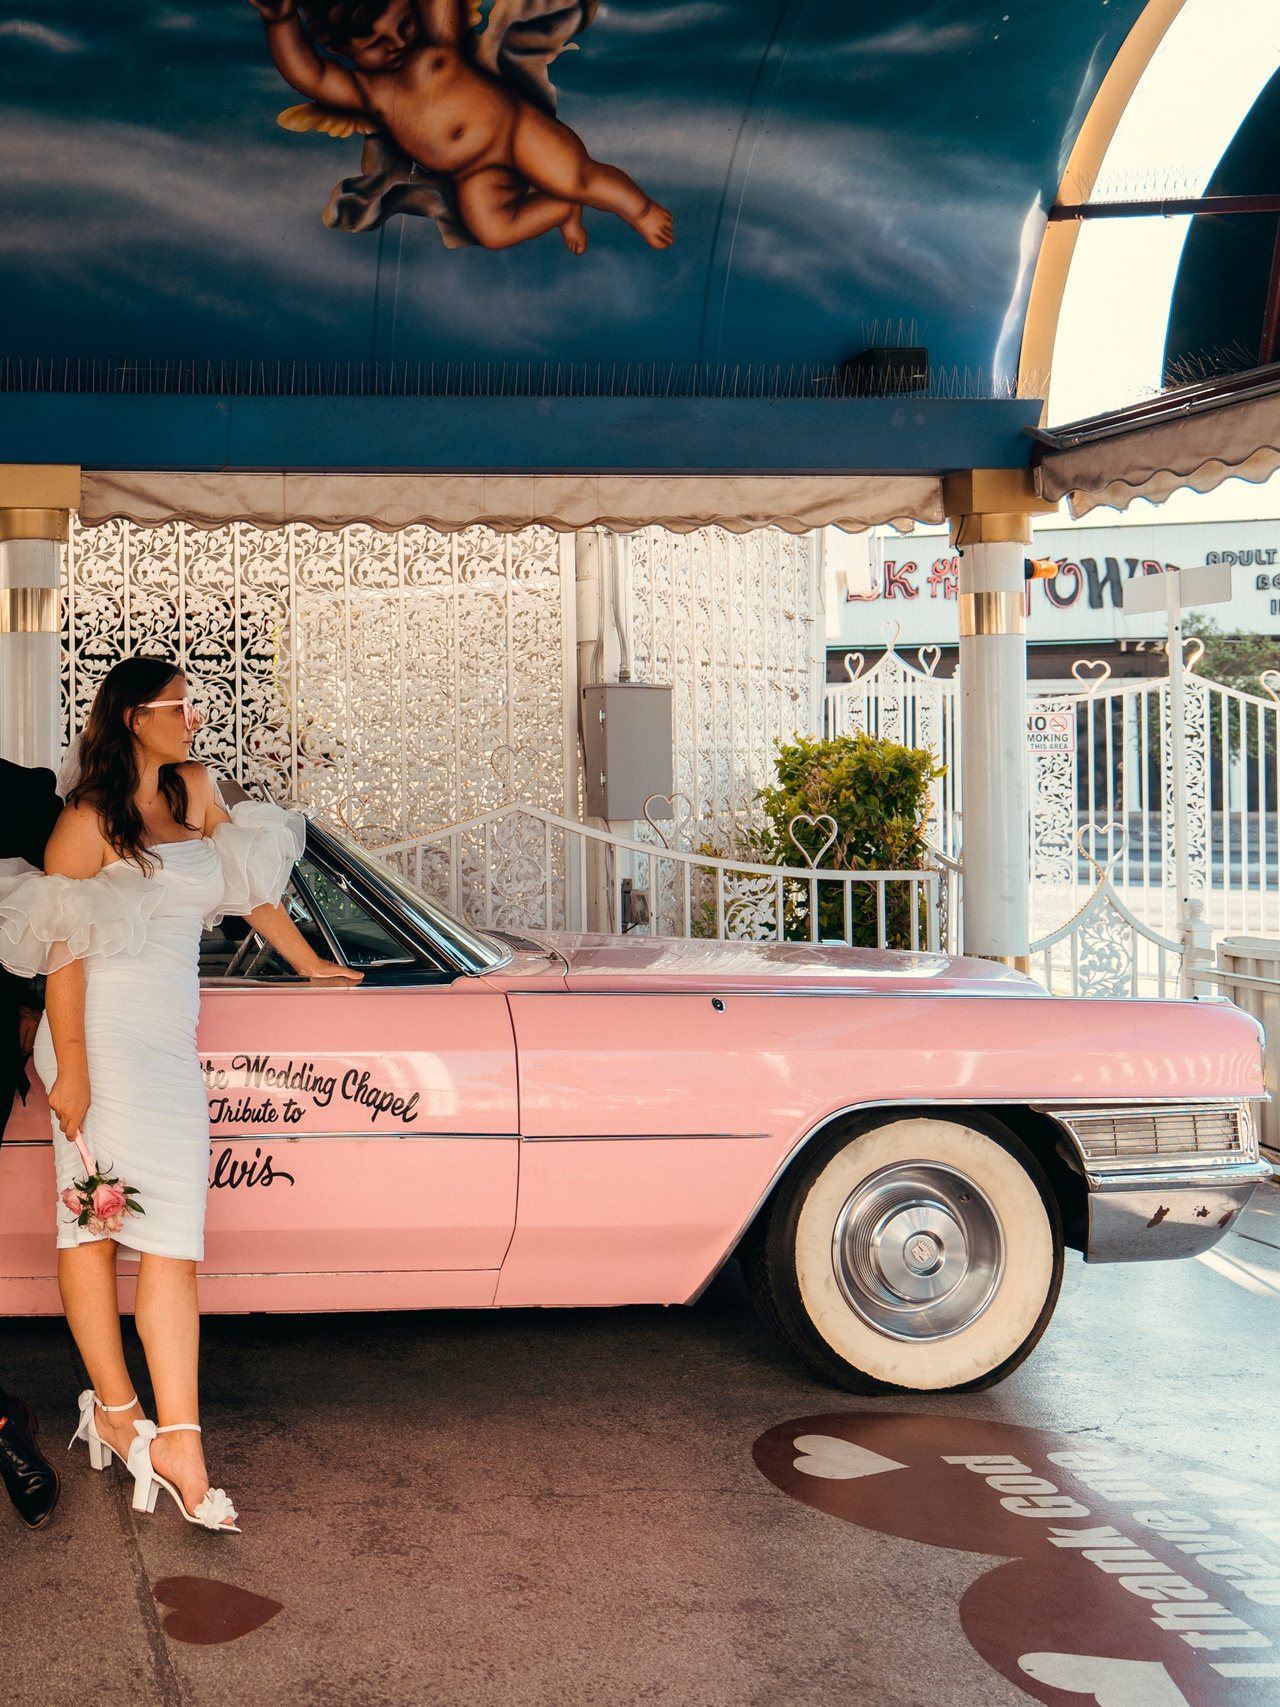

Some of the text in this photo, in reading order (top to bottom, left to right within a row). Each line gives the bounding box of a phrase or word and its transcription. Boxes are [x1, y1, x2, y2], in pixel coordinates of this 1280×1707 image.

[1206, 548, 1278, 567] ADULT
[1027, 733, 1069, 742] MOKING
[231, 1053, 338, 1108] Wedding
[341, 1068, 421, 1123] Chapel
[208, 1096, 307, 1124] Tribute to
[207, 1147, 295, 1189] lvis
[940, 1454, 1091, 1518] God
[1046, 1525, 1273, 1651] thank
